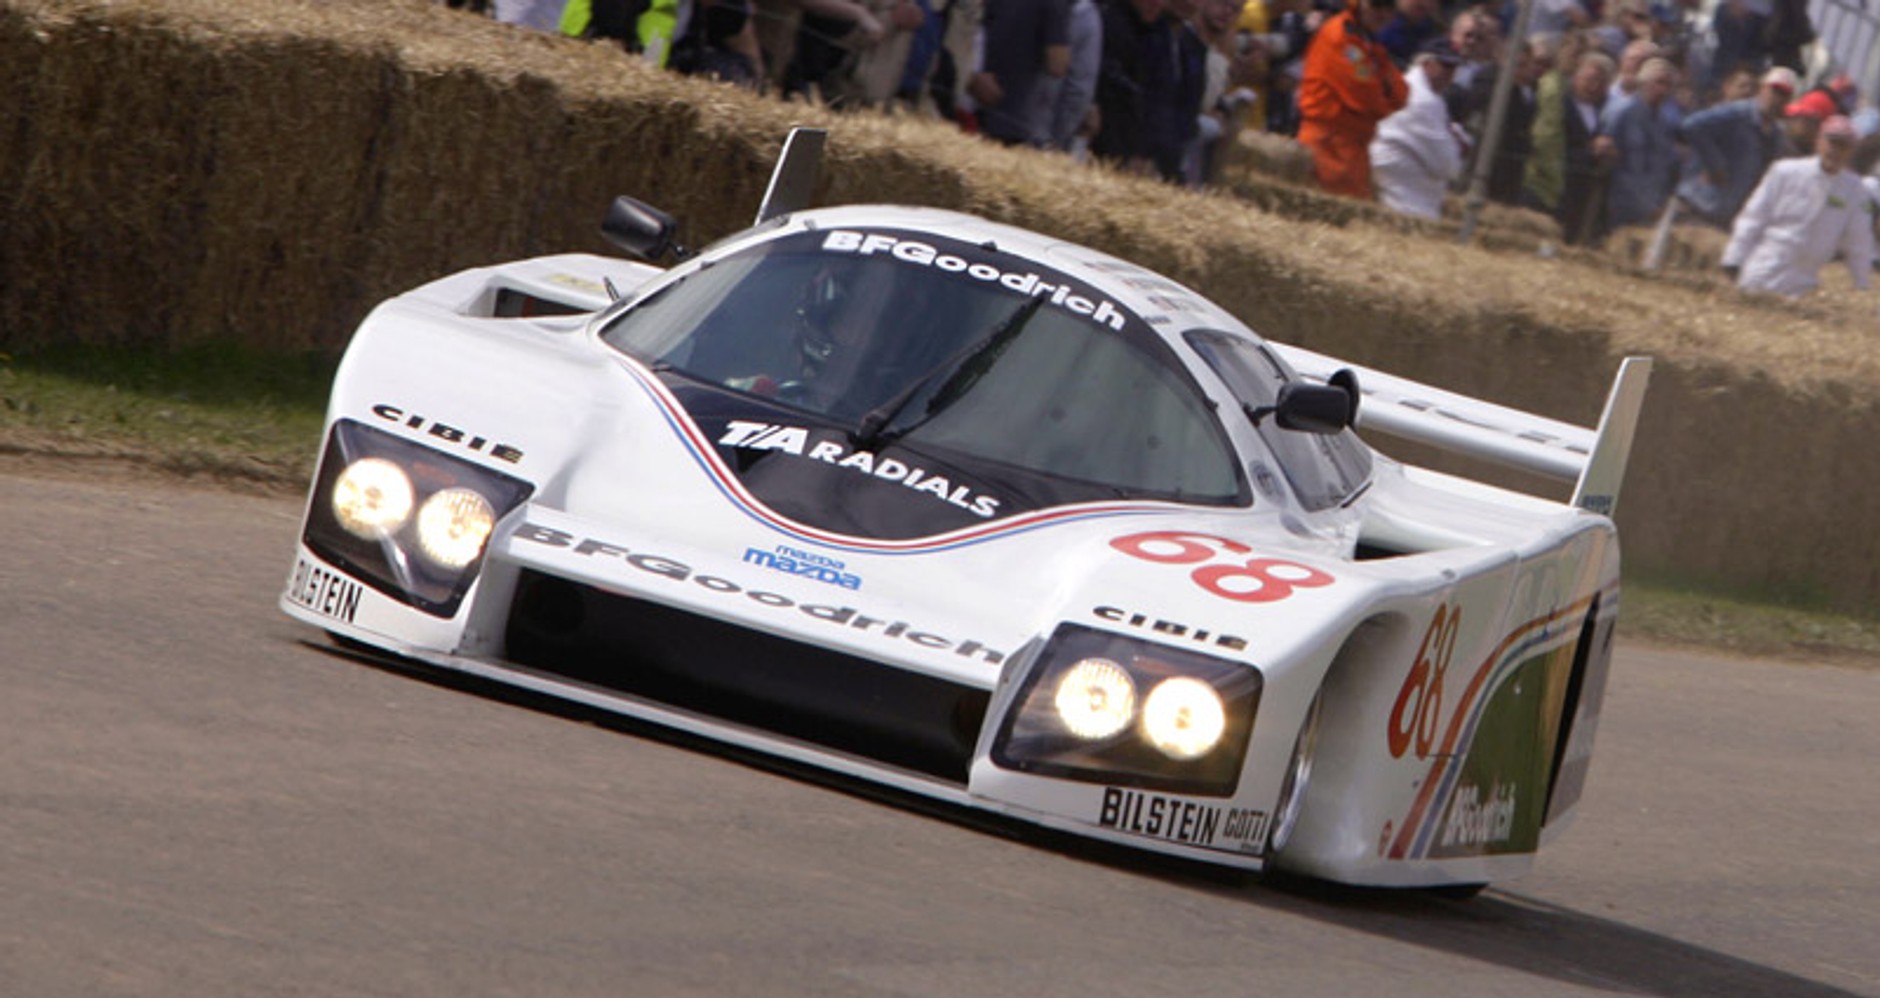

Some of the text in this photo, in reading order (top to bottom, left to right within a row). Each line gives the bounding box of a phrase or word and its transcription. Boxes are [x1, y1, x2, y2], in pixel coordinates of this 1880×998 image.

[821, 230, 1127, 331] BFGoodrich
[372, 404, 524, 463] CIBIE
[809, 440, 1001, 518] RADIALS
[511, 522, 1007, 665] BFGoodrich
[1109, 530, 1336, 603] 68
[1093, 606, 1249, 651] CIBIE
[1387, 602, 1462, 762] 68
[1100, 786, 1221, 845] BILSTEIN
